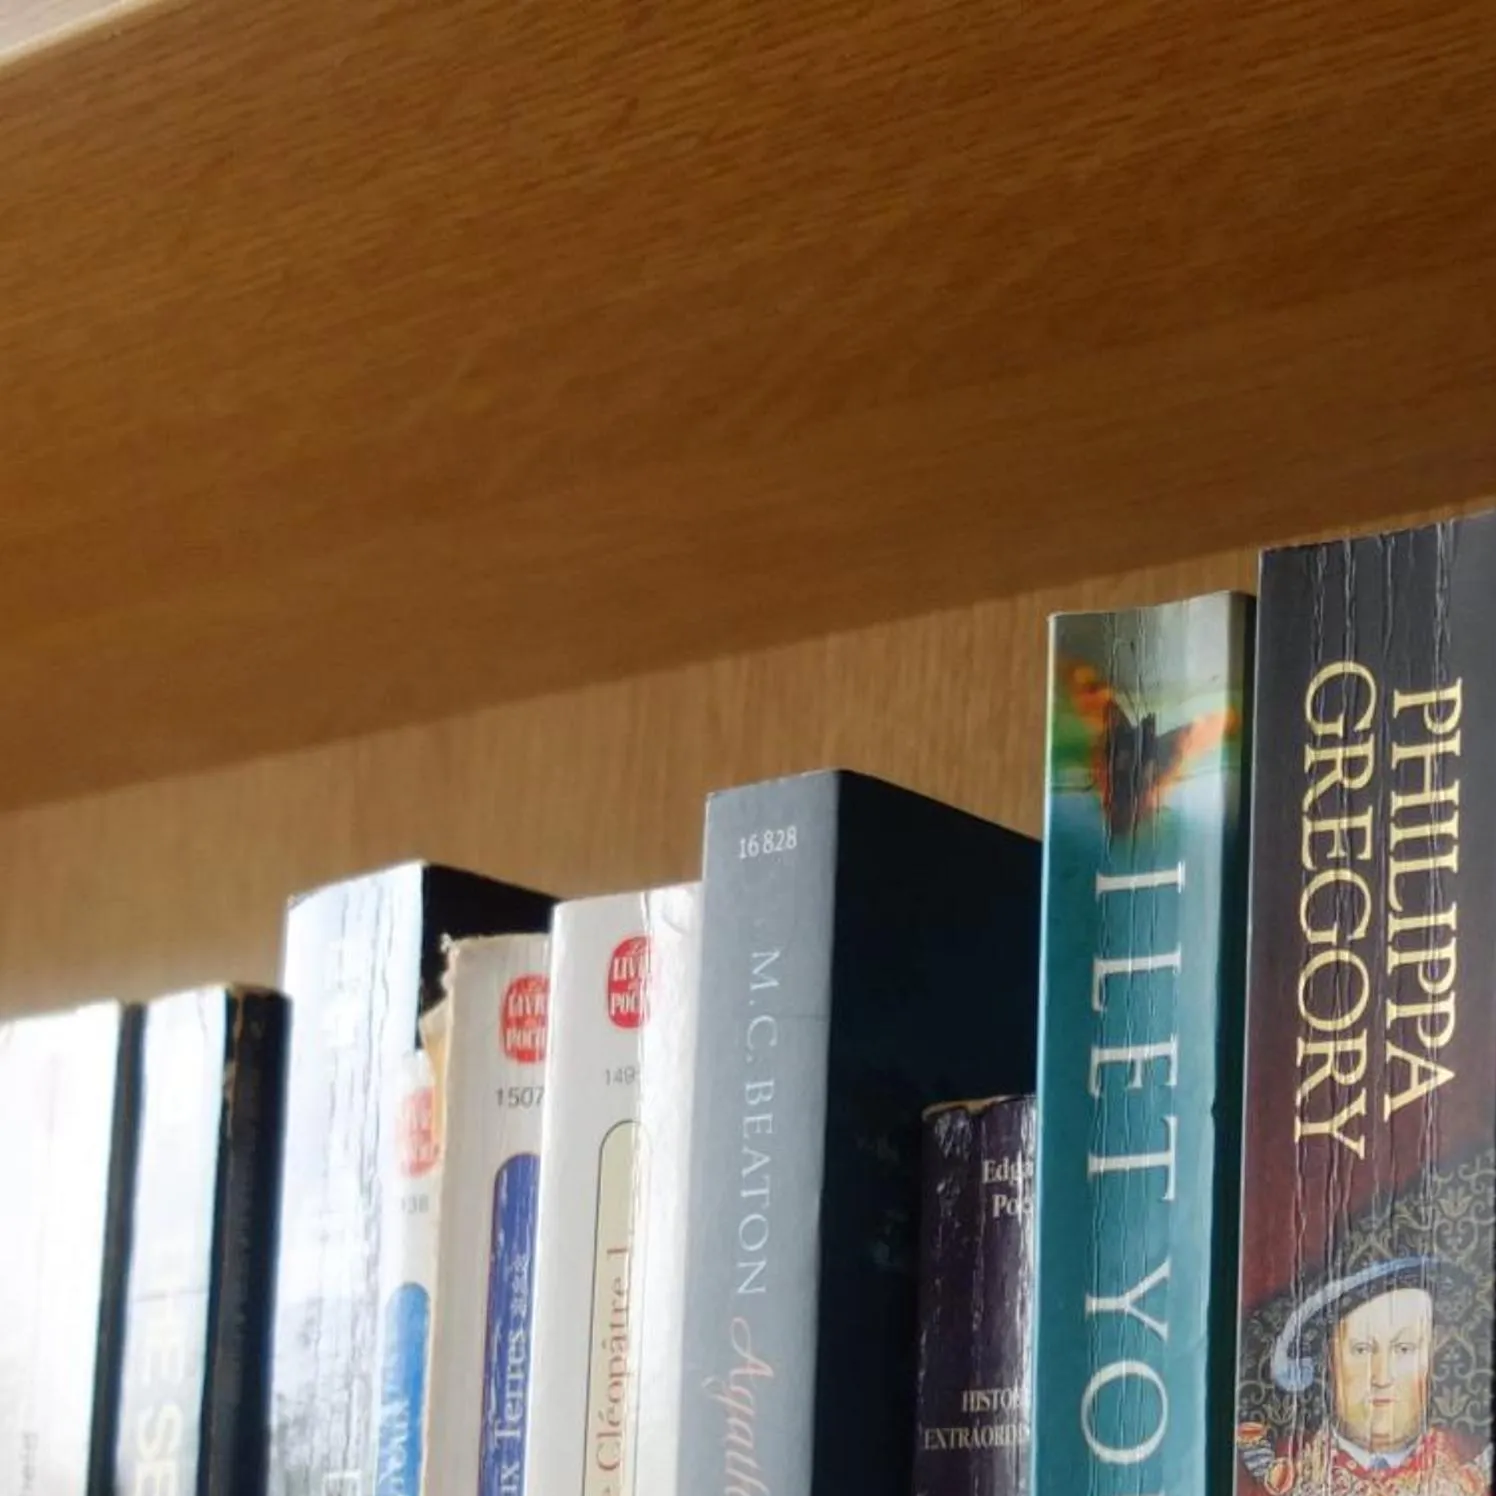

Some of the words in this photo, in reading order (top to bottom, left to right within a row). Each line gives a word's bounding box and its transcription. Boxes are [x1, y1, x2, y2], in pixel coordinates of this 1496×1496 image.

[1095, 861, 1186, 895] I
[1294, 659, 1377, 1160] GREGORY
[1383, 677, 1463, 1123] PHILIPPA
[1087, 943, 1182, 1202] LET
[735, 1078, 775, 1296] BEATON
[493, 1329, 530, 1448] Terres
[596, 1276, 633, 1472] Cléopâtre
